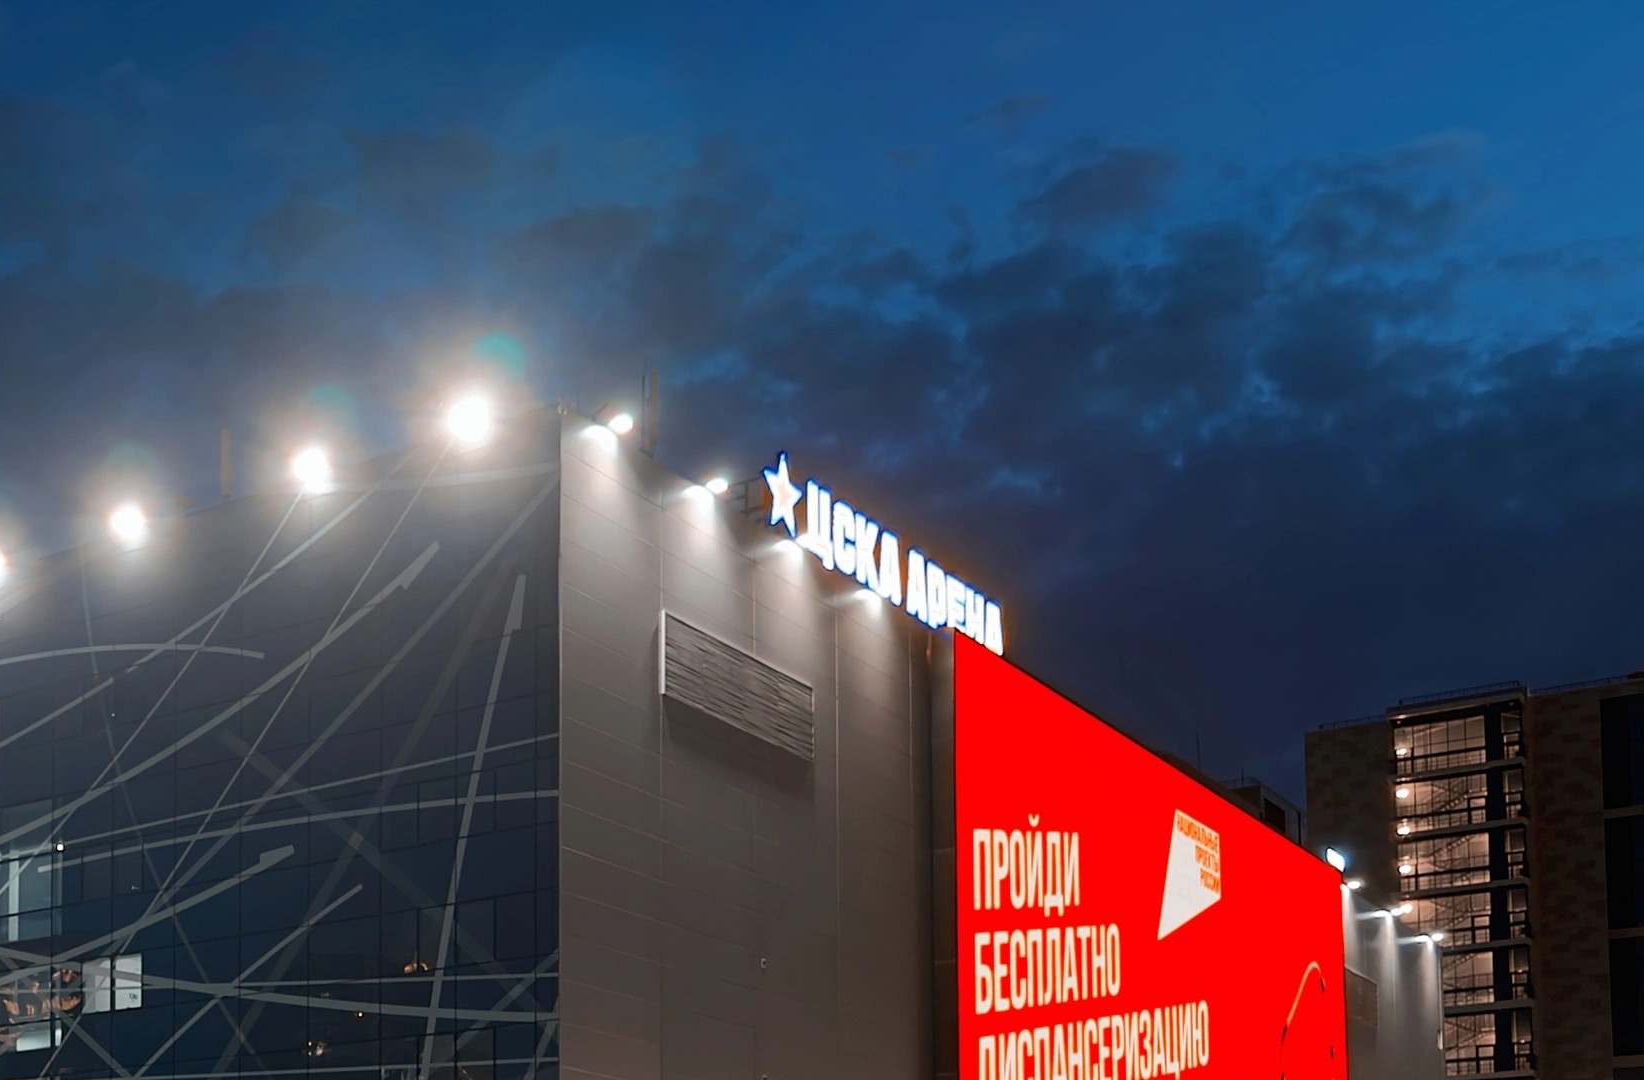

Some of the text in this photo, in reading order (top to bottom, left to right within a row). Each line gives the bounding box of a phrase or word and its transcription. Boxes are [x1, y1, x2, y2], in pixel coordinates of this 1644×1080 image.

[806, 480, 1004, 656] ЦСКА АРЕНА
[973, 814, 1080, 917] ПРОЙДИ
[975, 923, 1121, 1014] БЕСПЛАТНО
